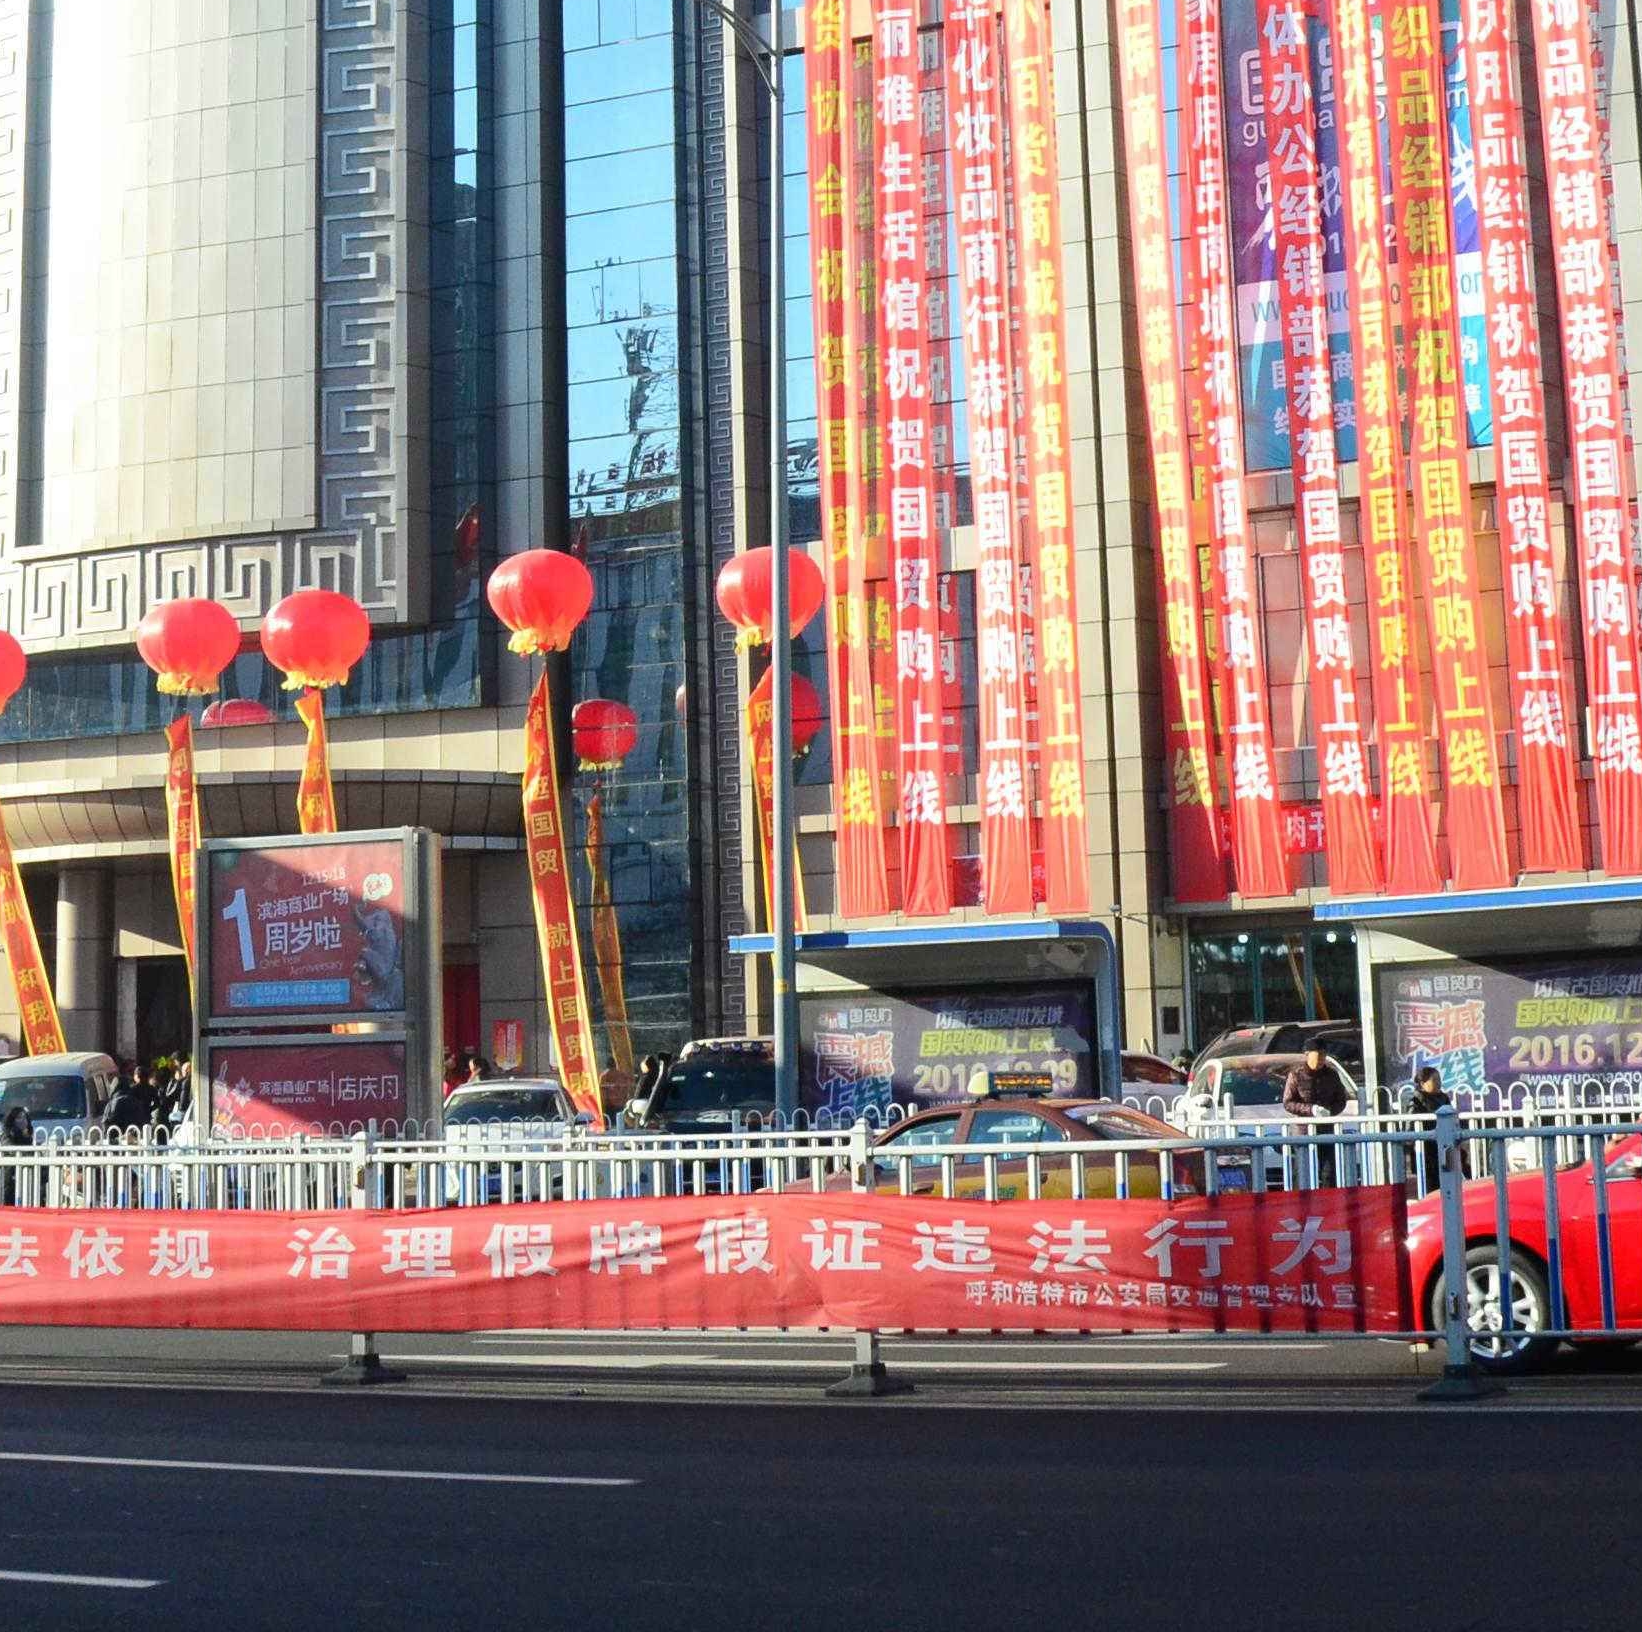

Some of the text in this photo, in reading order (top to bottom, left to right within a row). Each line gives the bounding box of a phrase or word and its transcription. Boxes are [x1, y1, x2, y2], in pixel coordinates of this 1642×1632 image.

[256, 886, 350, 921] 滨海商业广场
[264, 916, 343, 957] 周岁啦
[286, 1215, 1356, 1282] 治理假牌假证违法行为
